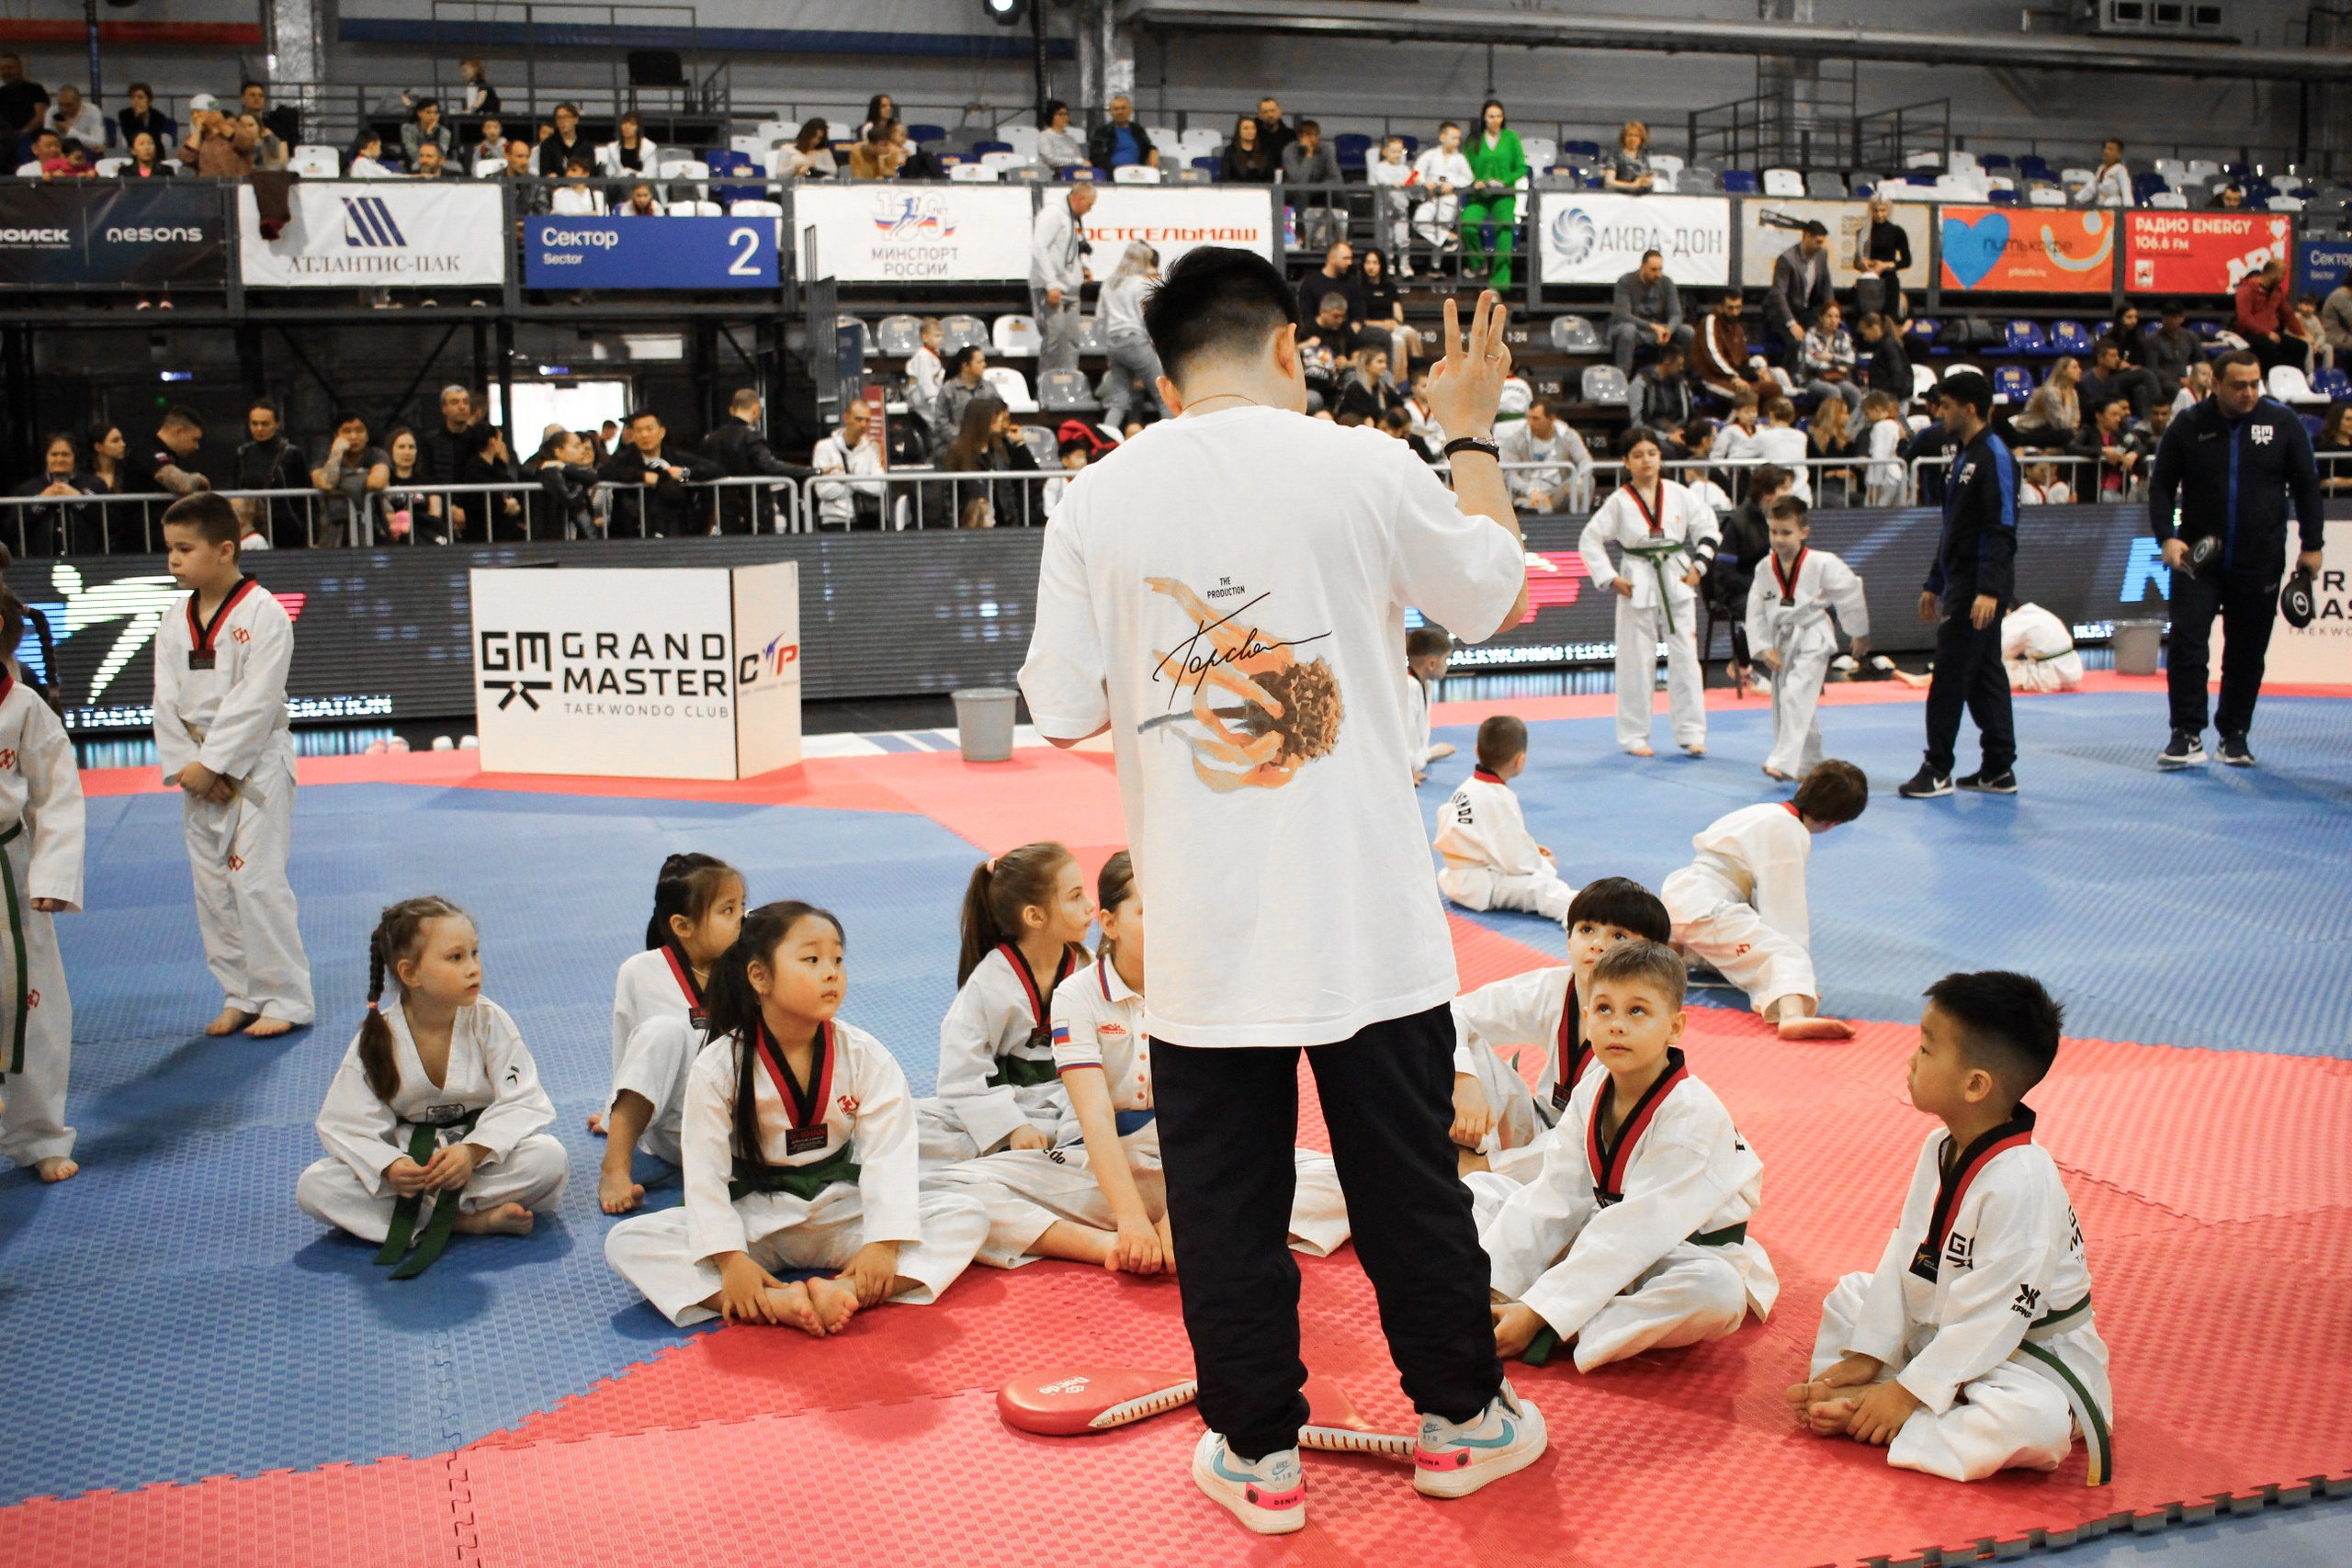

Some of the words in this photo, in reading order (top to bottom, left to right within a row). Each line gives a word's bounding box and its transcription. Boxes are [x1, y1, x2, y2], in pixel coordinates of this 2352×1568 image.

[2134, 217, 2190, 234] РАДИО
[2192, 218, 2252, 235] ENERGY
[541, 227, 619, 250] Сектор
[1076, 227, 1258, 242] ОСТСЕЛЬМАШ
[1599, 227, 1723, 258] АКВА-ДОН
[2135, 235, 2169, 250] 106.6
[2173, 237, 2189, 251] FM
[543, 253, 584, 265] Sector
[728, 227, 763, 276] 2
[871, 247, 959, 262] МИНСПОРТ
[287, 254, 461, 275] АТЛАНТИС-ПАК
[884, 262, 949, 276] РОССИИ
[1219, 576, 1231, 586] THE
[1207, 585, 1246, 600] PRODUCTION
[481, 631, 551, 671] GM
[561, 632, 726, 660] GRAND
[563, 667, 728, 697] MASTER
[565, 703, 675, 717] TAEKWONDO
[684, 705, 729, 718] CLUB
[1274, 1472, 1293, 1482] AIR
